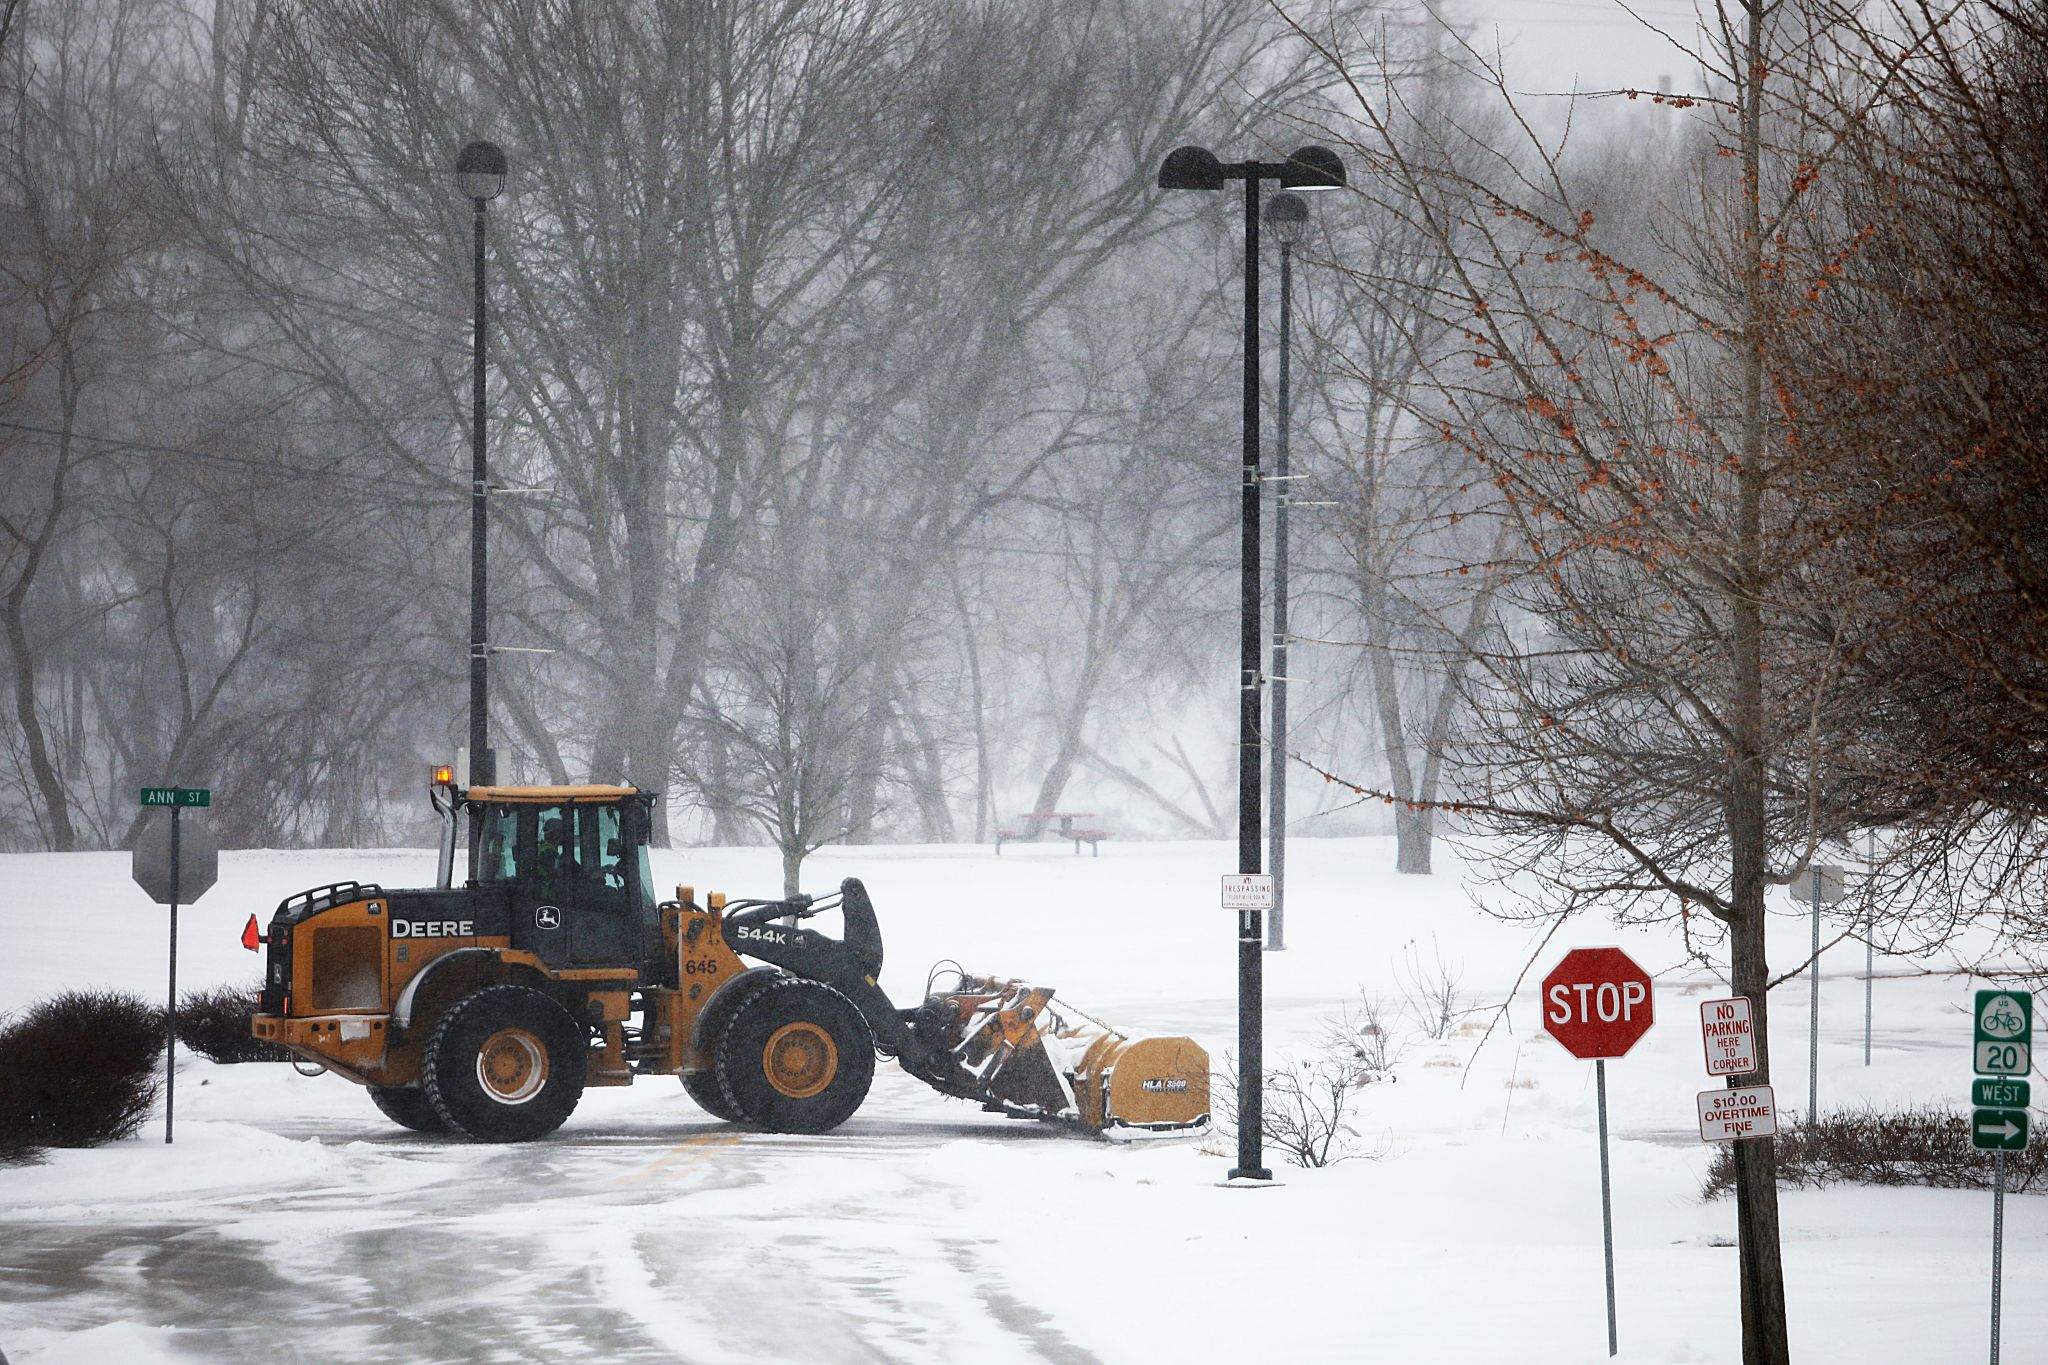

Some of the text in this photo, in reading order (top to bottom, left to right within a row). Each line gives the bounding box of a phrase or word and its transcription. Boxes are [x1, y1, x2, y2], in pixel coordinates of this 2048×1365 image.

[148, 790, 201, 804] ANN ST
[392, 919, 474, 938] DEERE
[737, 926, 786, 945] 544K
[686, 960, 717, 974] 645
[1549, 981, 1646, 1024] STOP
[1717, 1004, 1735, 1019] NO
[1705, 1020, 1749, 1037] PARKING
[1717, 1036, 1740, 1047] HERE
[1724, 1047, 1736, 1058] TO
[1987, 1045, 2017, 1069] 20
[1713, 1057, 1749, 1070] CORNER
[1142, 1080, 1162, 1089] HLA
[1982, 1084, 2020, 1101] WEST
[1713, 1095, 1757, 1109] $10.00
[1705, 1106, 1770, 1121] OVERTIME
[1724, 1121, 1753, 1132] FINE
